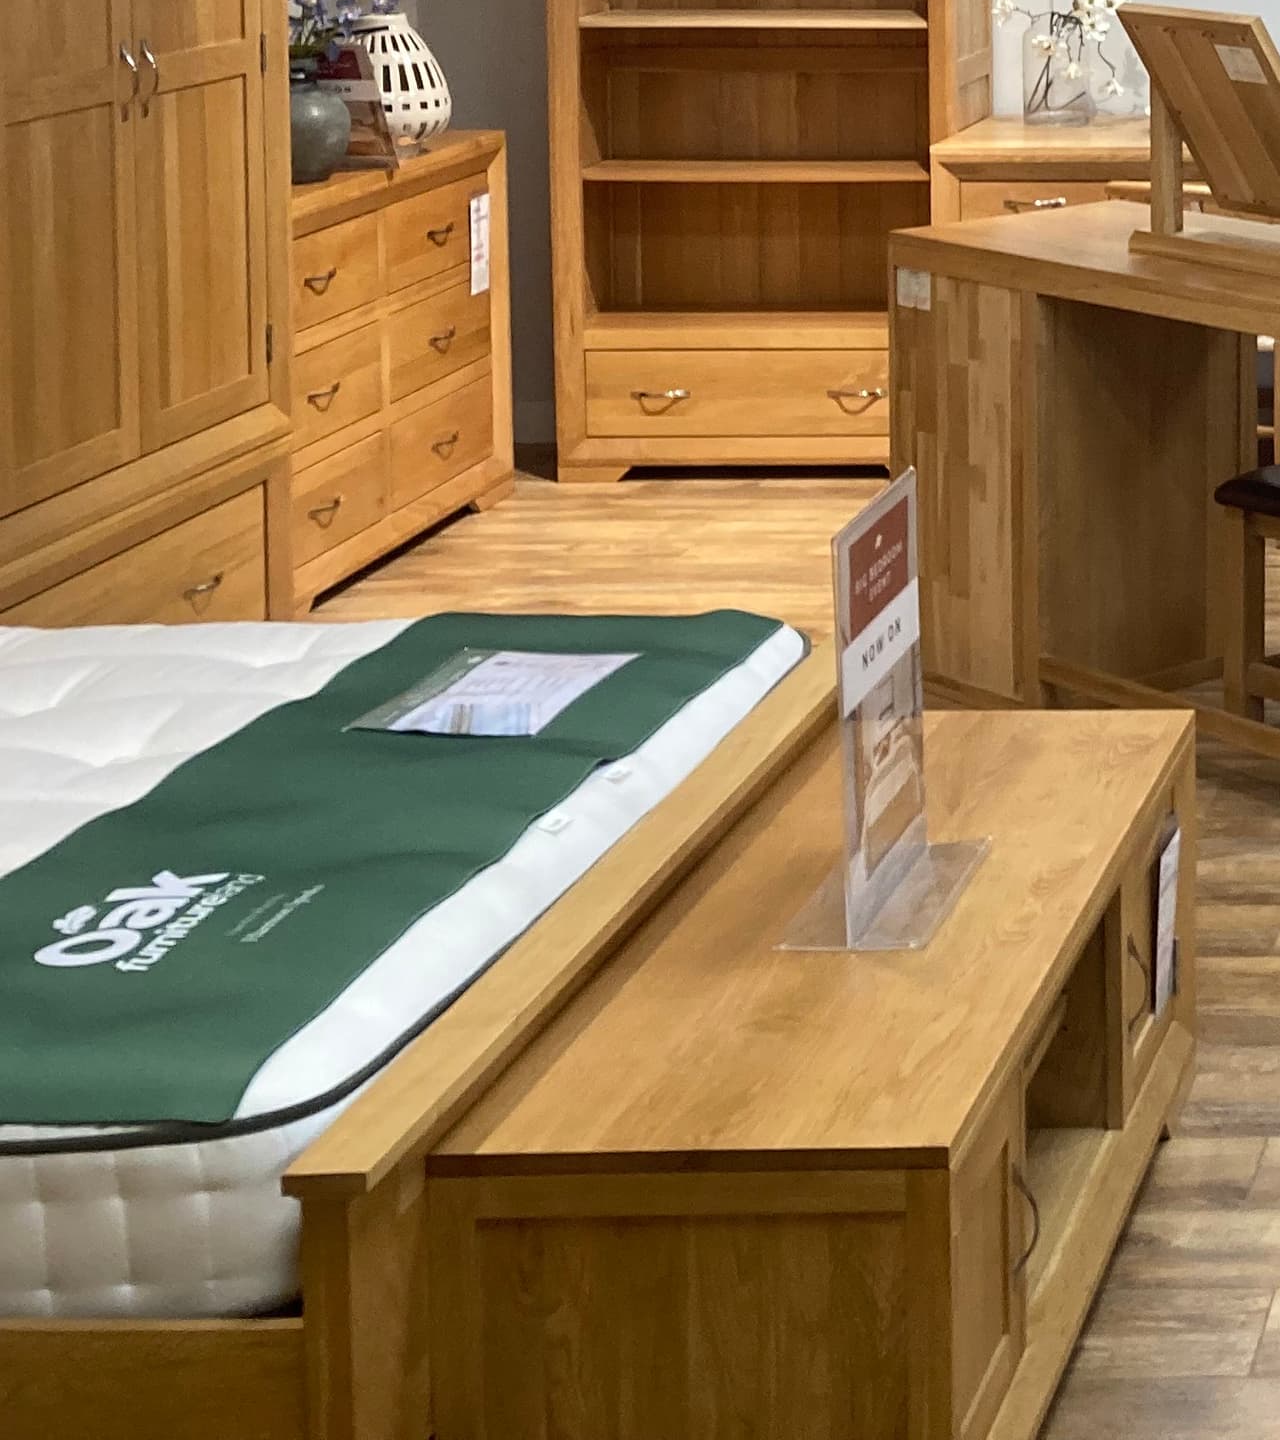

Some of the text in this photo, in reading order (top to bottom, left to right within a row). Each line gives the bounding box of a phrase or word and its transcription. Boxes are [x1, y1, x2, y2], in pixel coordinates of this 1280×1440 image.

[861, 616, 902, 671] NOW ON
[33, 870, 231, 968] Oak
